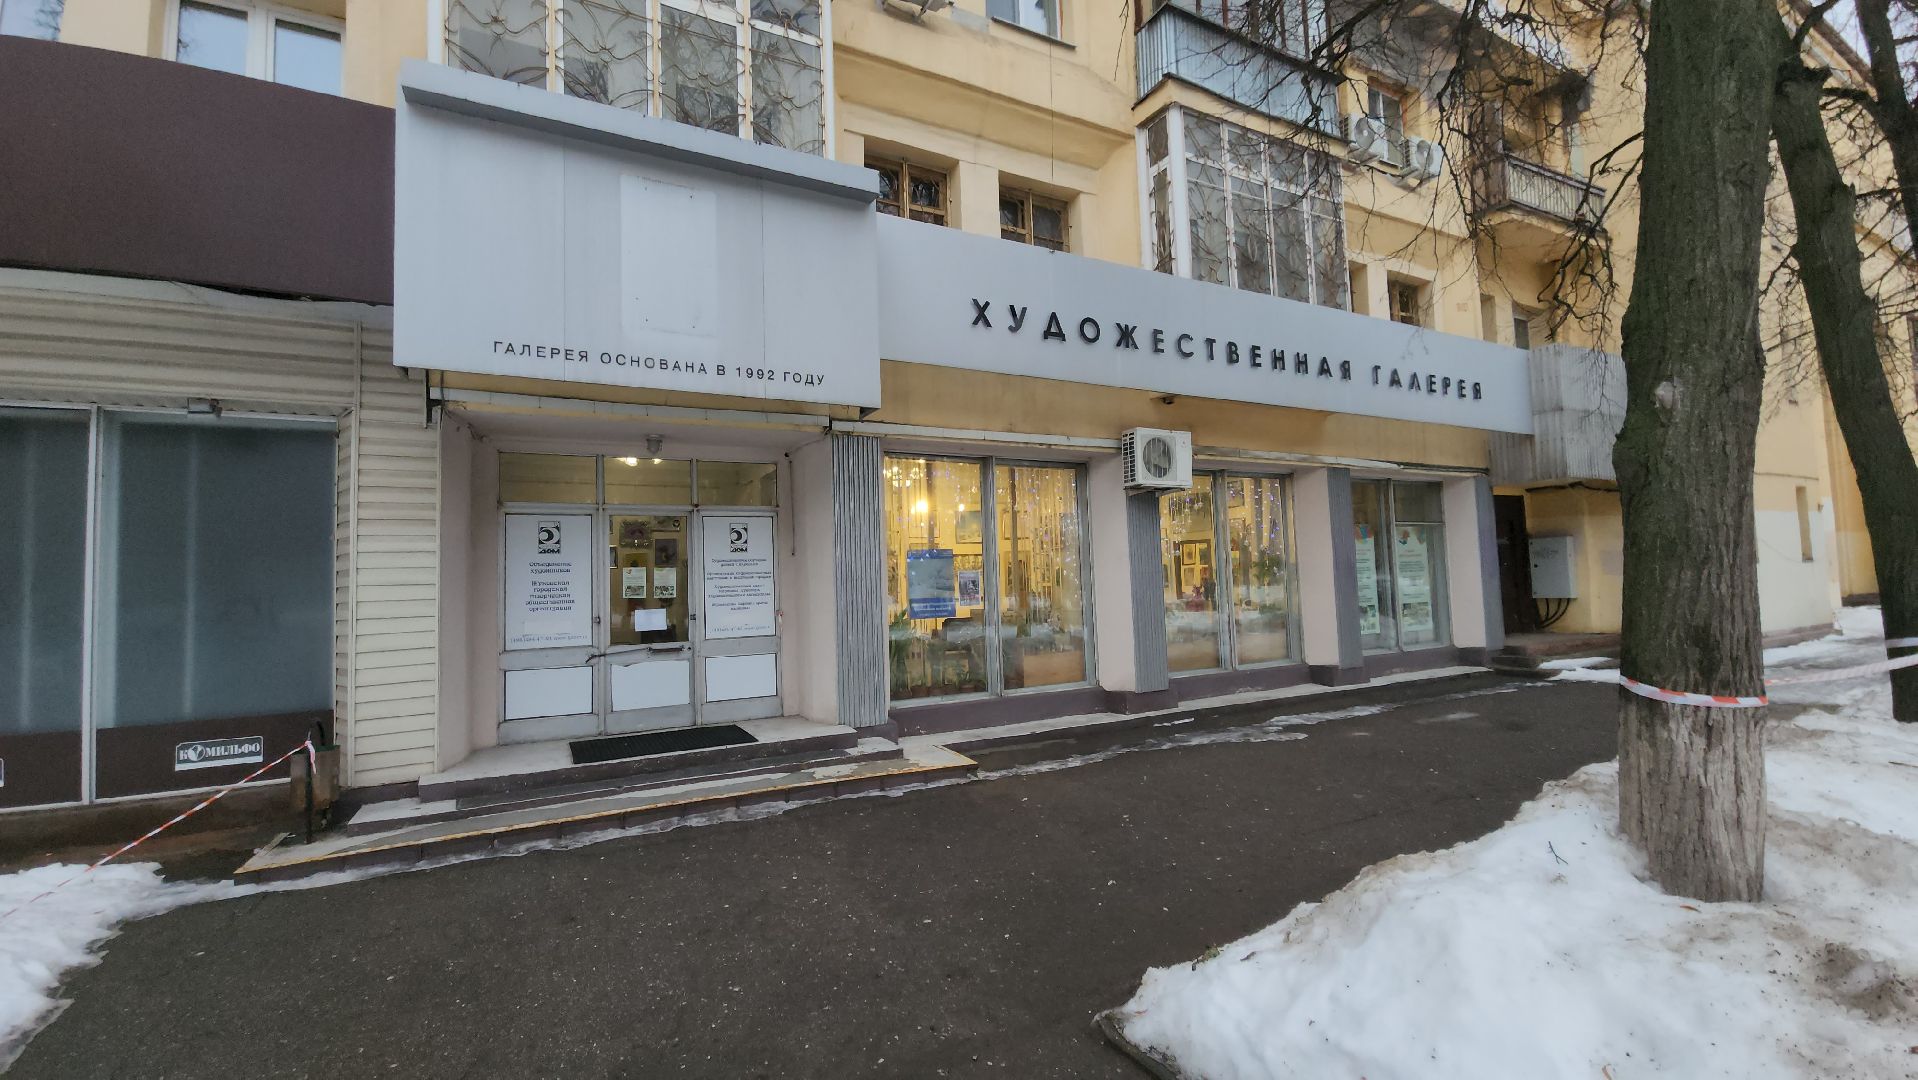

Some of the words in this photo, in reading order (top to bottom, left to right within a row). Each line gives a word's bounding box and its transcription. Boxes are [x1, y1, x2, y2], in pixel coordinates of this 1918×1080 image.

[493, 341, 589, 363] ГАЛЕРЕЯ
[600, 352, 708, 375] ОСНОВАНА
[716, 364, 727, 376] В
[735, 366, 776, 381] 1992
[783, 371, 825, 387] ГОДУ
[971, 297, 1352, 381] ХУДОЖЕСТВЕННАЯ
[1372, 365, 1483, 401] ГАЛЕРЕЯ
